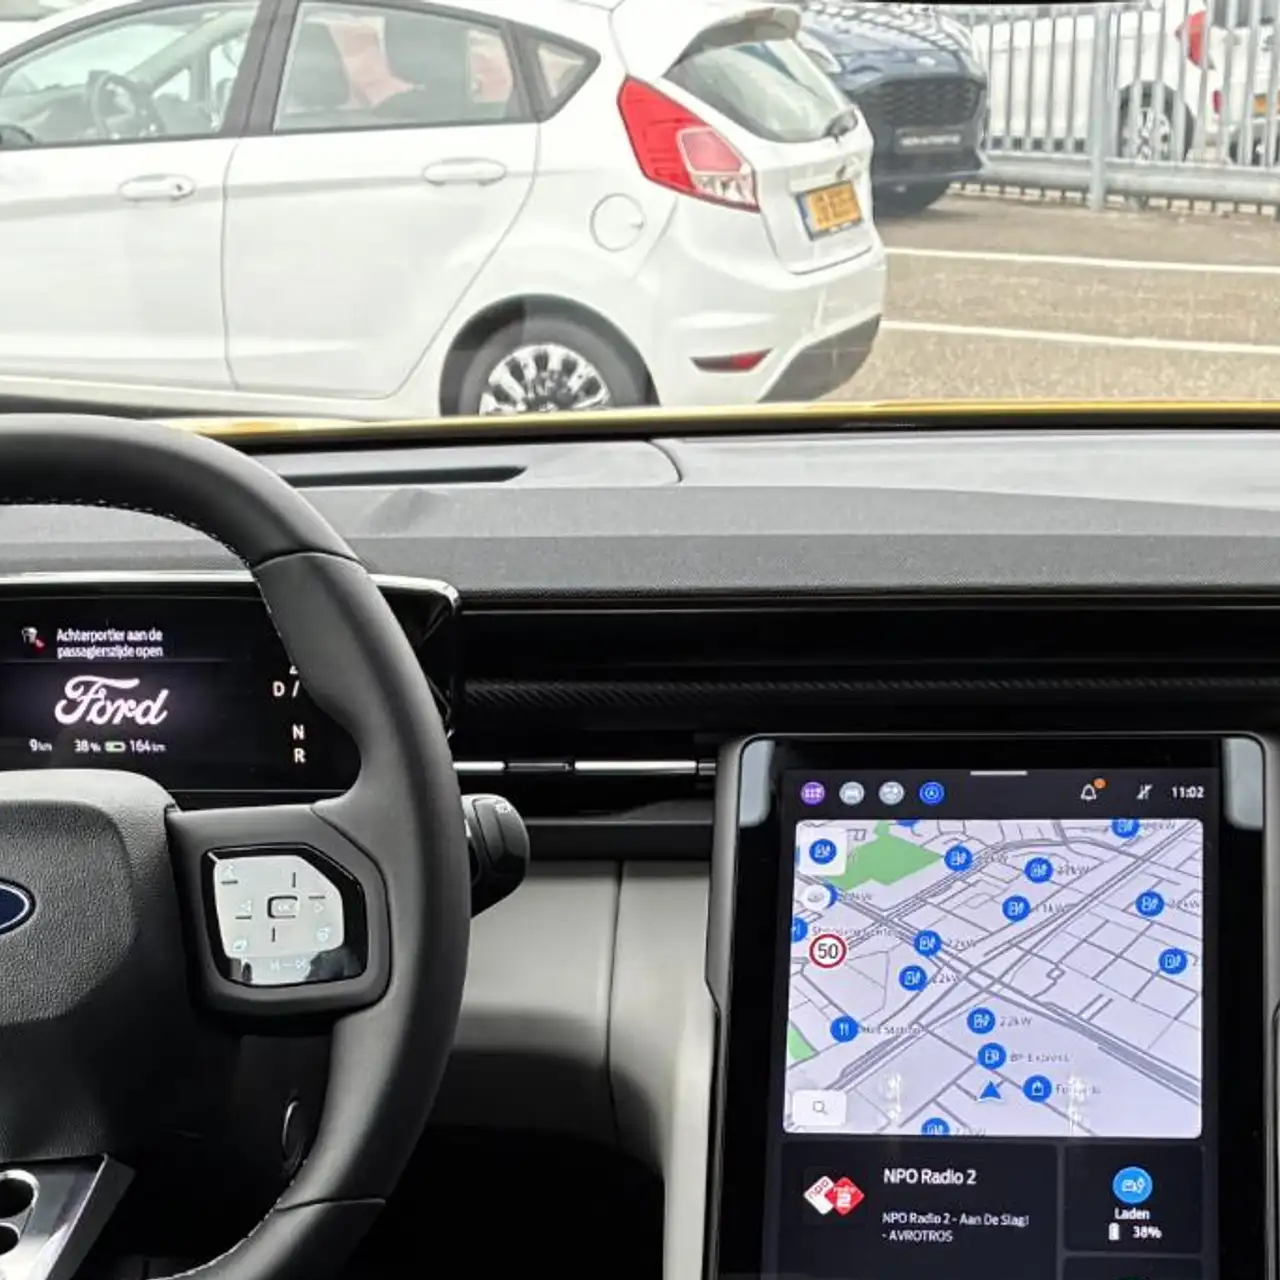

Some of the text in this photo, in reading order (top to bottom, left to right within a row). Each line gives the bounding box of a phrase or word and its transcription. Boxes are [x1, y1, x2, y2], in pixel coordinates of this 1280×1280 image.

[56, 628, 163, 642] Achterportier aan de
[136, 647, 164, 659] open
[272, 680, 286, 697] D
[54, 674, 169, 726] Ford
[292, 723, 305, 740] N
[293, 747, 306, 763] R
[1171, 786, 1205, 799] 11:02
[818, 942, 840, 960] 50
[883, 1168, 977, 1185] NPO Radio 2
[882, 1212, 908, 1224] NPO
[909, 1212, 942, 1225] Radio
[943, 1213, 951, 1225] 2
[959, 1213, 982, 1225] Aan
[983, 1214, 999, 1226] De
[1000, 1214, 1029, 1228] Slag!
[1114, 1207, 1151, 1220] Laden
[888, 1229, 954, 1243] AVROTROS
[1132, 1226, 1162, 1239] 38%
